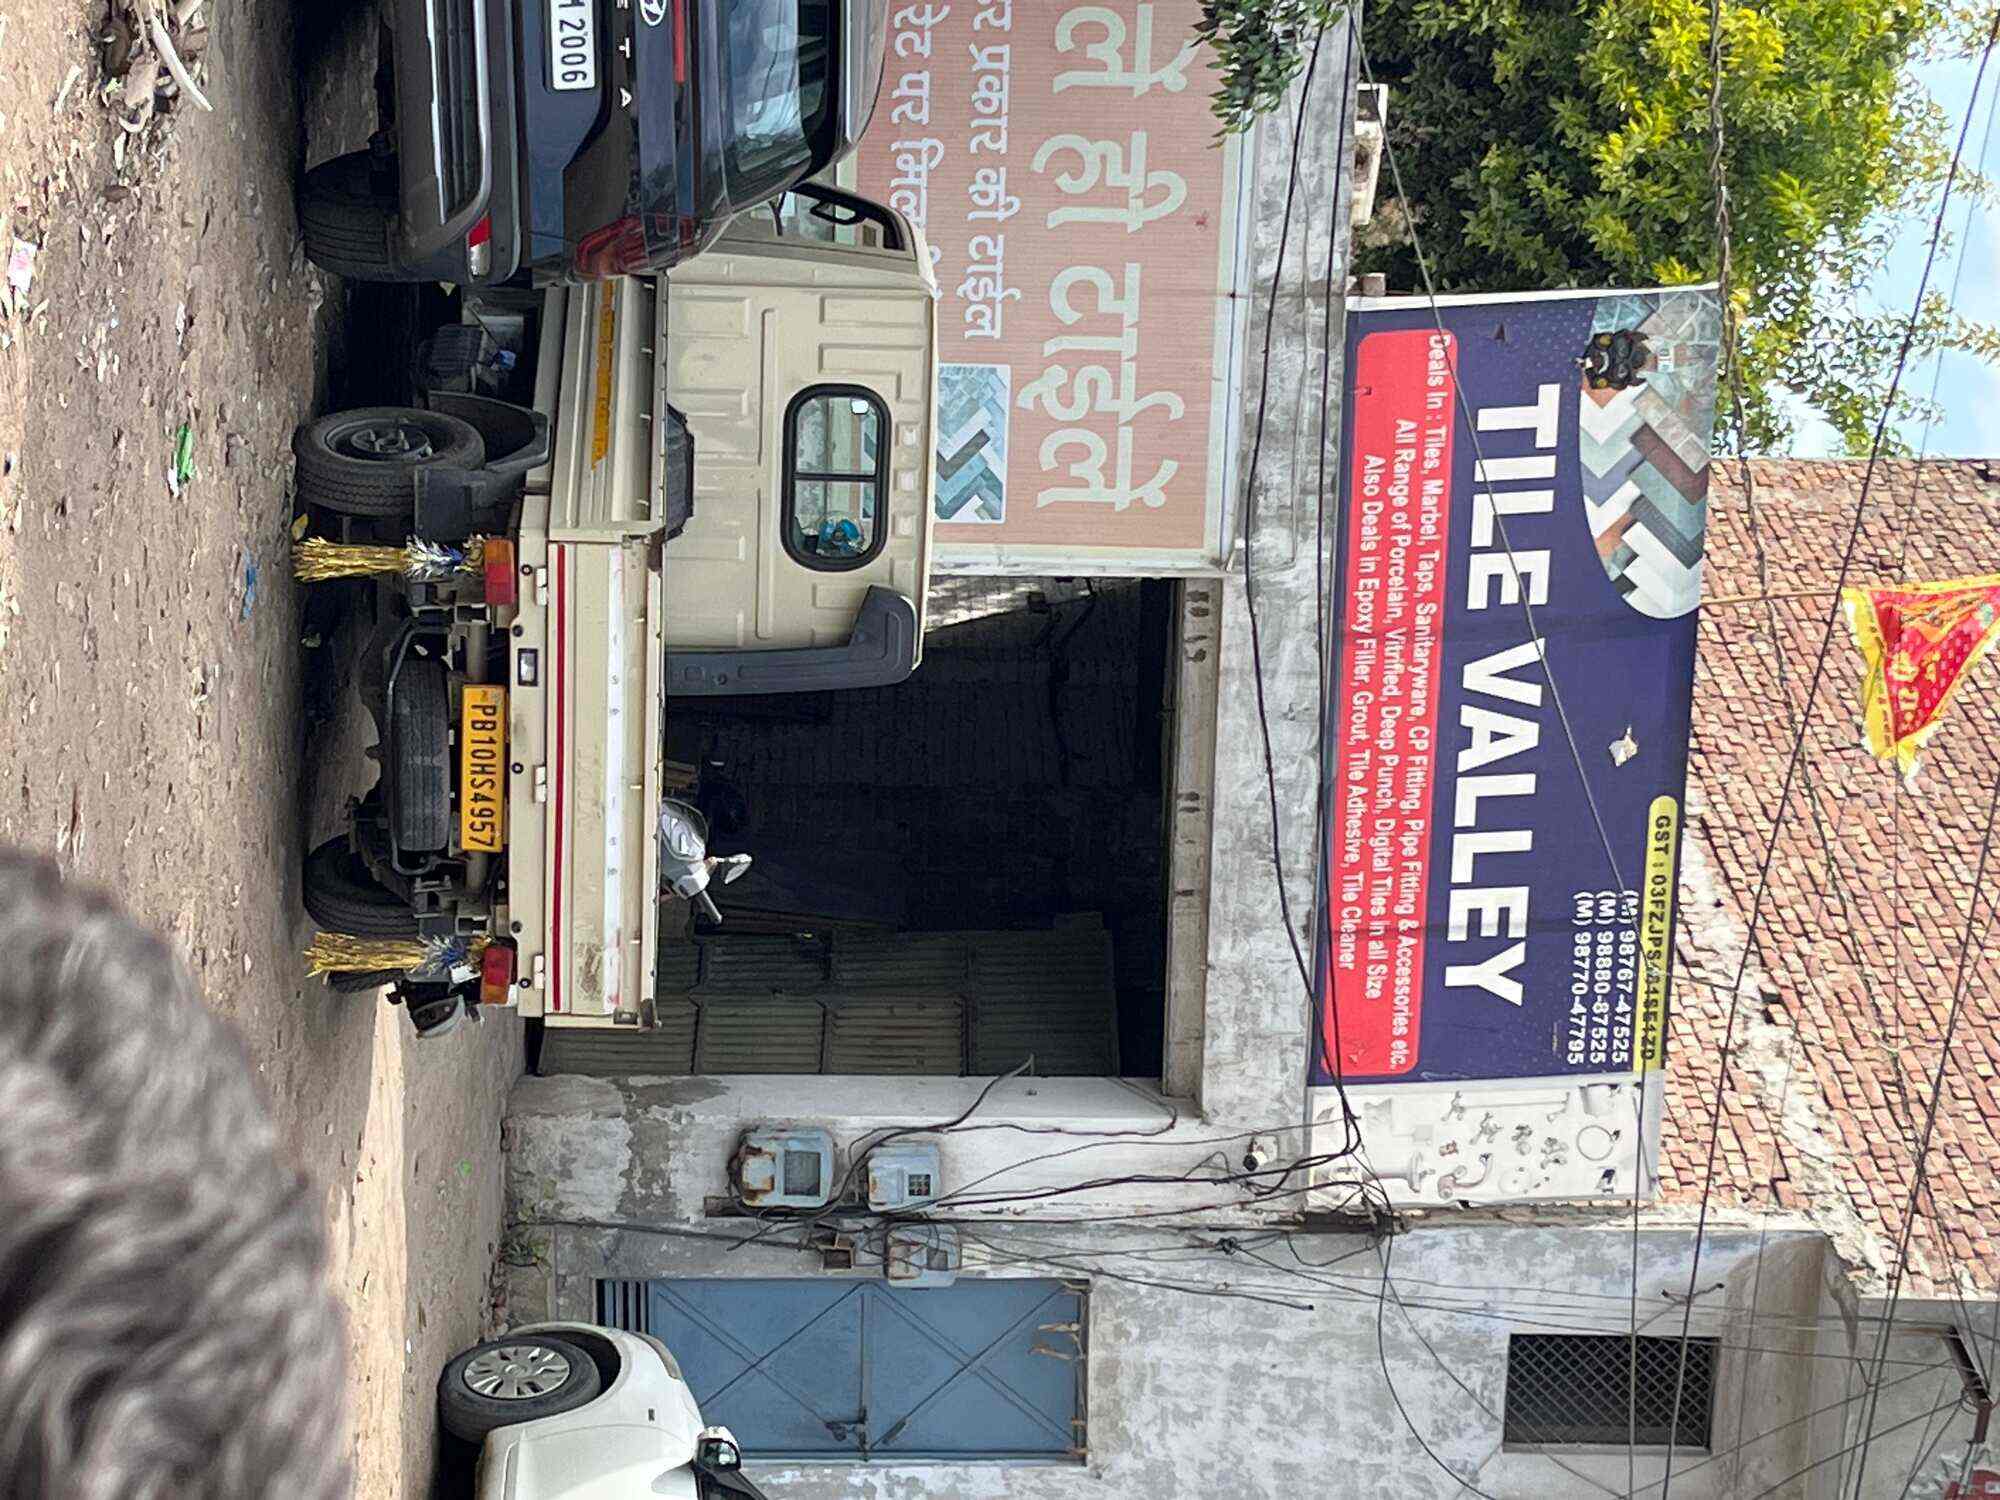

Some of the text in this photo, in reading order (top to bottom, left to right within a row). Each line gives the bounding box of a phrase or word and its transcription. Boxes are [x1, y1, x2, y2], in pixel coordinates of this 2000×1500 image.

[559, 18, 587, 83] 2006
[892, 4, 950, 59] रेट
[890, 70, 932, 125] पर
[968, 43, 1012, 156] प्रकार
[967, 168, 1022, 222] की
[1015, 0, 1198, 512] लें ही टाईलें
[958, 234, 1022, 340] टाईल
[1427, 335, 1451, 386] Deals
[1395, 419, 1419, 443] All
[1420, 425, 1446, 475] Tiles,
[1363, 454, 1387, 496] Also
[1387, 449, 1416, 507] Range
[1360, 501, 1384, 551] Deals
[1391, 512, 1412, 530] of
[1417, 479, 1444, 546] Marbel,
[1383, 535, 1411, 624] Porcelain,
[1413, 550, 1440, 598] Taps,
[1350, 578, 1380, 634] Epoxy
[1350, 638, 1378, 687] Filler,
[1379, 628, 1407, 701] Vitrified,
[1406, 603, 1437, 721] Sanitaryware,
[1347, 691, 1374, 746] Grout,
[1445, 383, 1560, 1007] TILE VALLEY
[1376, 706, 1402, 750] Deep
[1408, 726, 1430, 751] CP
[468, 704, 497, 847] PB10HS4957
[1348, 749, 1371, 781] Tile
[1372, 755, 1399, 814] Punch,
[1399, 755, 1429, 815] Fitting,
[1340, 785, 1368, 868] Adhesive,
[1369, 819, 1396, 872] Digital
[1399, 819, 1425, 856] Pipe
[1651, 815, 1670, 856] GST
[1341, 871, 1364, 903] Tile
[1370, 877, 1394, 916] Tiles
[1393, 861, 1423, 914] Fitting
[1339, 906, 1362, 970] Cleaner
[1367, 941, 1388, 959] all
[1398, 919, 1419, 932] &
[1365, 964, 1388, 999] Size
[1391, 935, 1418, 1036] Accessories
[1567, 892, 1594, 1065] (M) 98770-47795
[1590, 890, 1616, 1064] (M) 98880-87525
[1612, 890, 1639, 1063] (M) 98767-47525
[1390, 1040, 1410, 1070] etc.
